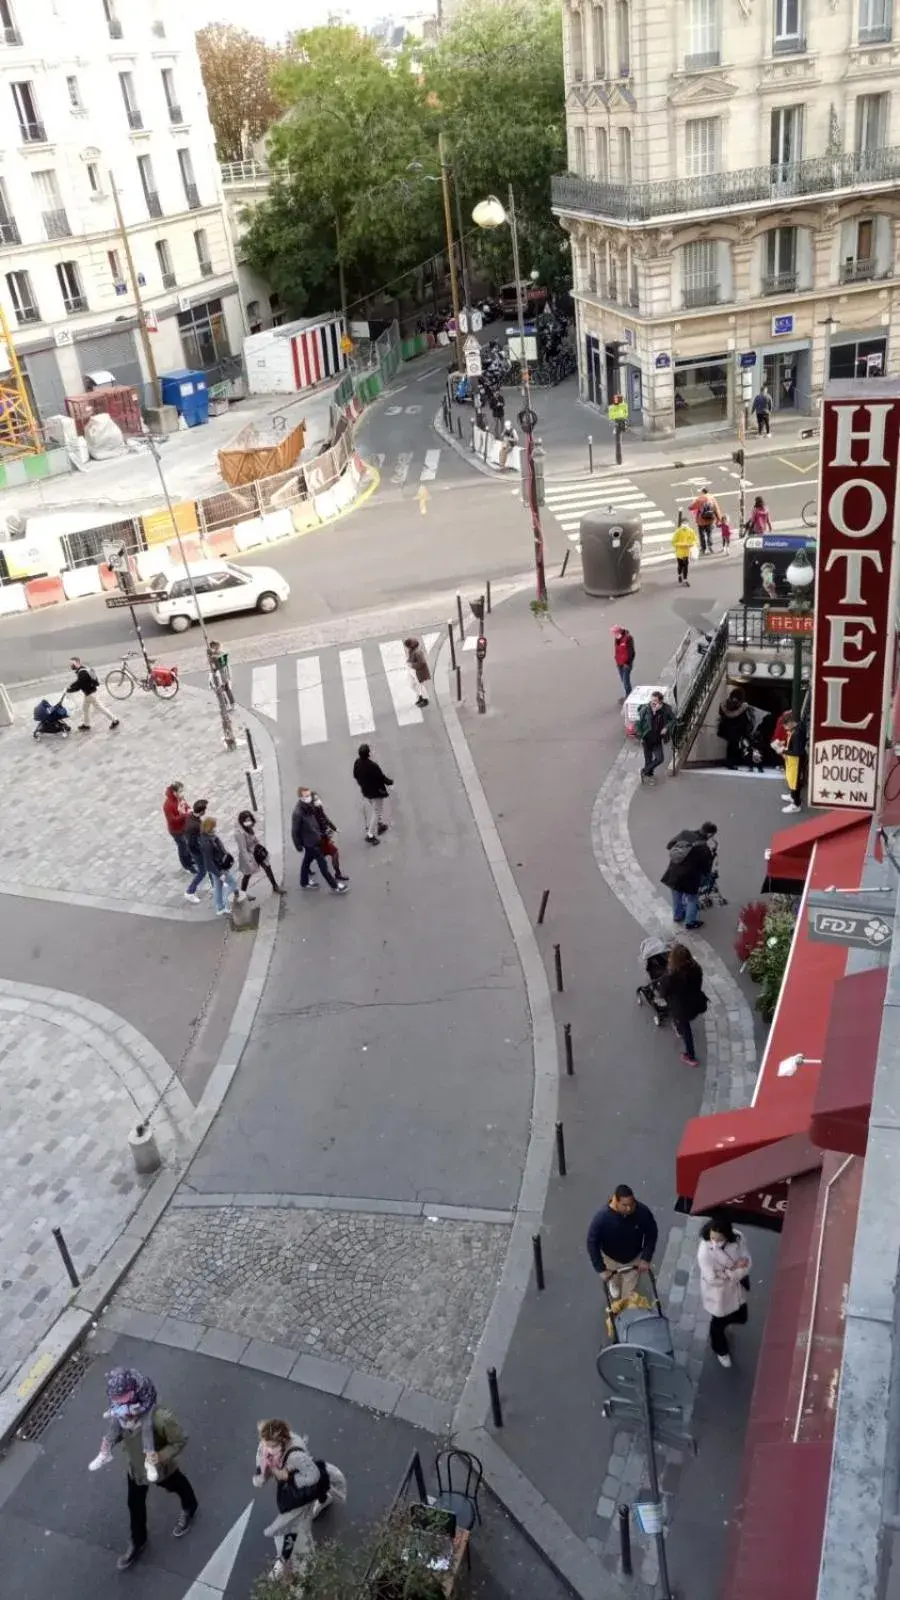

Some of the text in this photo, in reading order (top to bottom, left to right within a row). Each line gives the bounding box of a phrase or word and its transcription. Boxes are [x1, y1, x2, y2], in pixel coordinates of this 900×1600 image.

[821, 405, 895, 730] HOTEL
[771, 616, 813, 631] METR
[815, 744, 877, 770] LA PERDRIX
[822, 765, 865, 783] ROUGE
[849, 791, 868, 802] NN
[819, 918, 857, 933] FDJ
